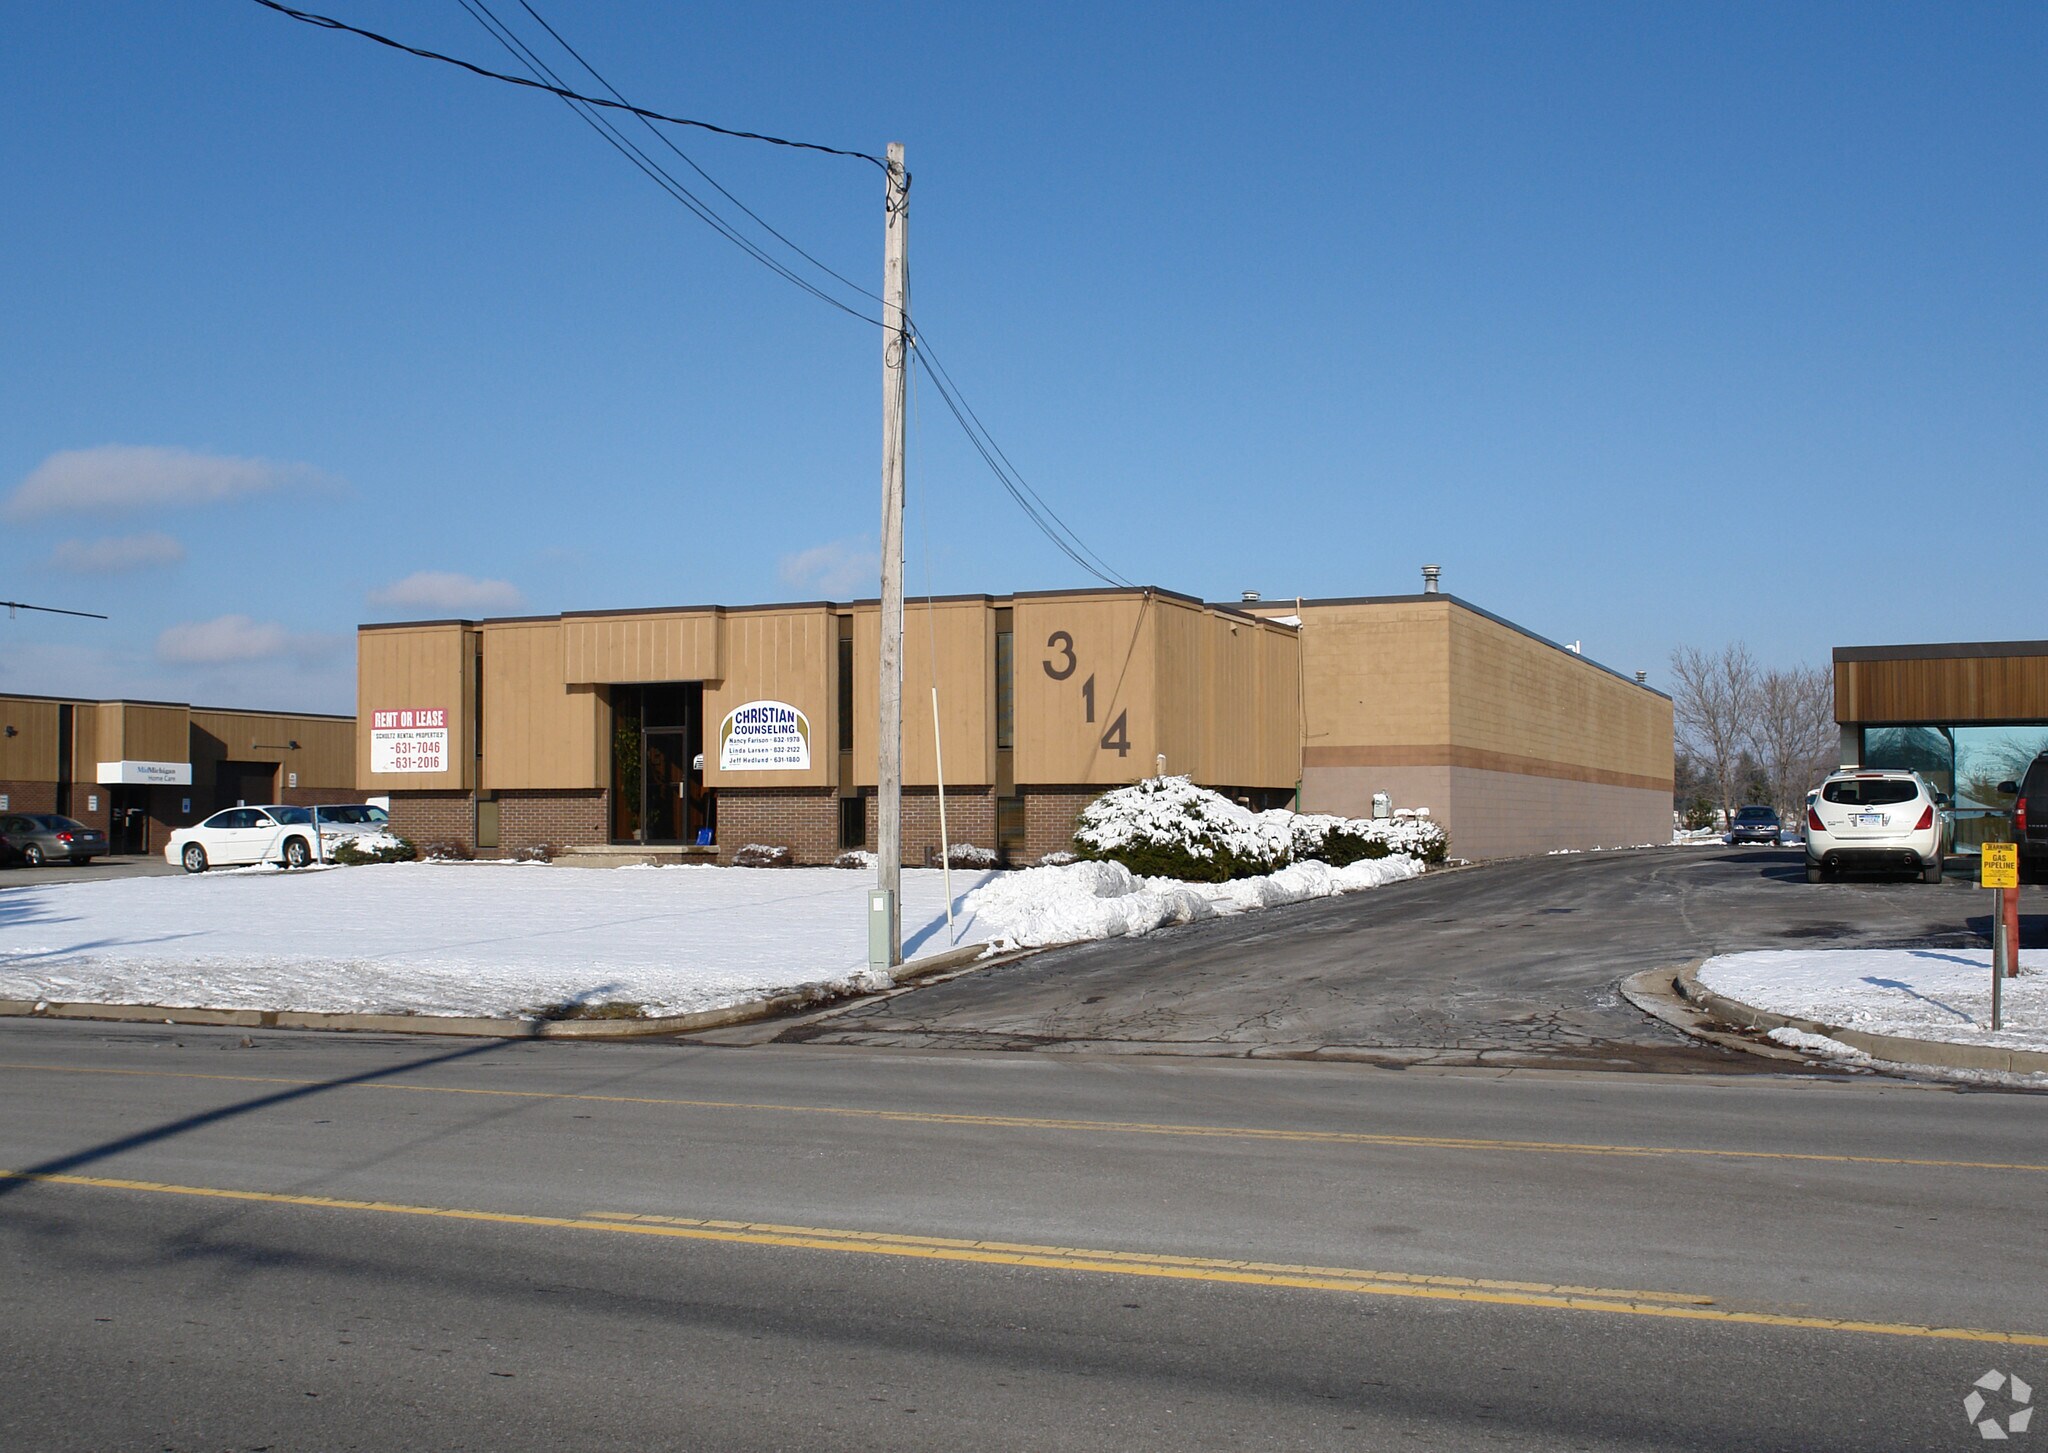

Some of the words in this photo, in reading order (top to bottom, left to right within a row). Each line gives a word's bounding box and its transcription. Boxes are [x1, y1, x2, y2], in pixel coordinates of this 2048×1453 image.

[374, 711, 398, 728] RENT
[400, 711, 413, 727] OR
[415, 710, 444, 727] LEASE
[735, 707, 795, 724] CHRISTIAN
[734, 724, 795, 735] COUNSELING
[1984, 861, 2015, 870] PIPELINE
